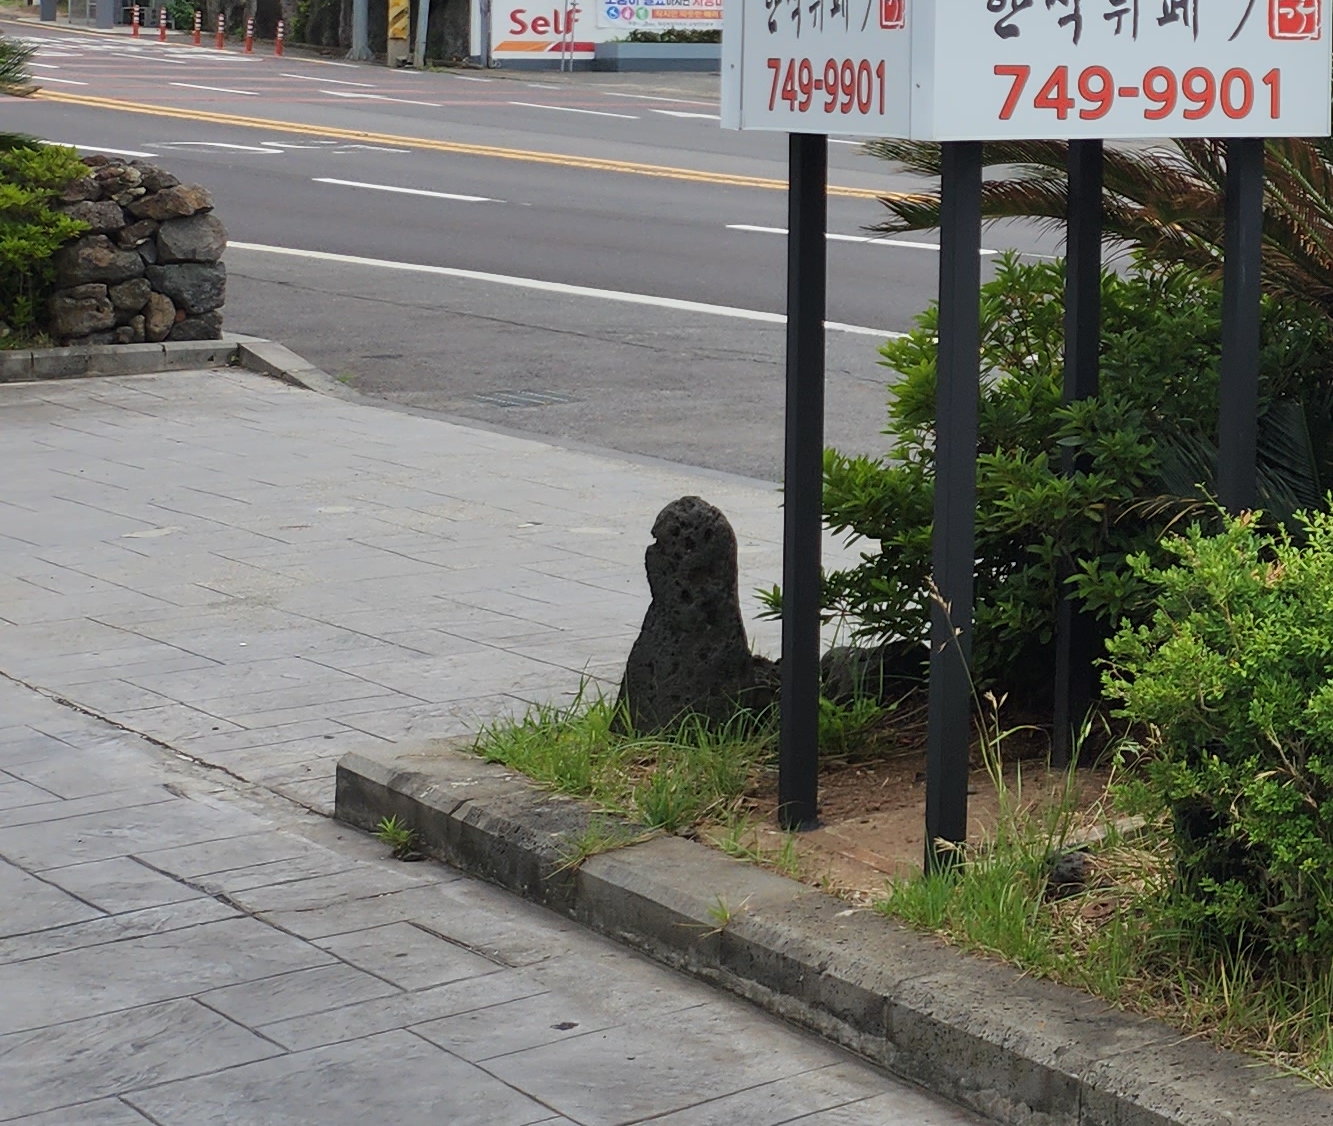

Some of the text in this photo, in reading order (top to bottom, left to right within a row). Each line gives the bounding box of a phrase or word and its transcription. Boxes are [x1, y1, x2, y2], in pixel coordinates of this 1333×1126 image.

[509, 8, 583, 36] Self
[767, 57, 886, 116] 749-9901
[993, 64, 1281, 122] 749-9901
